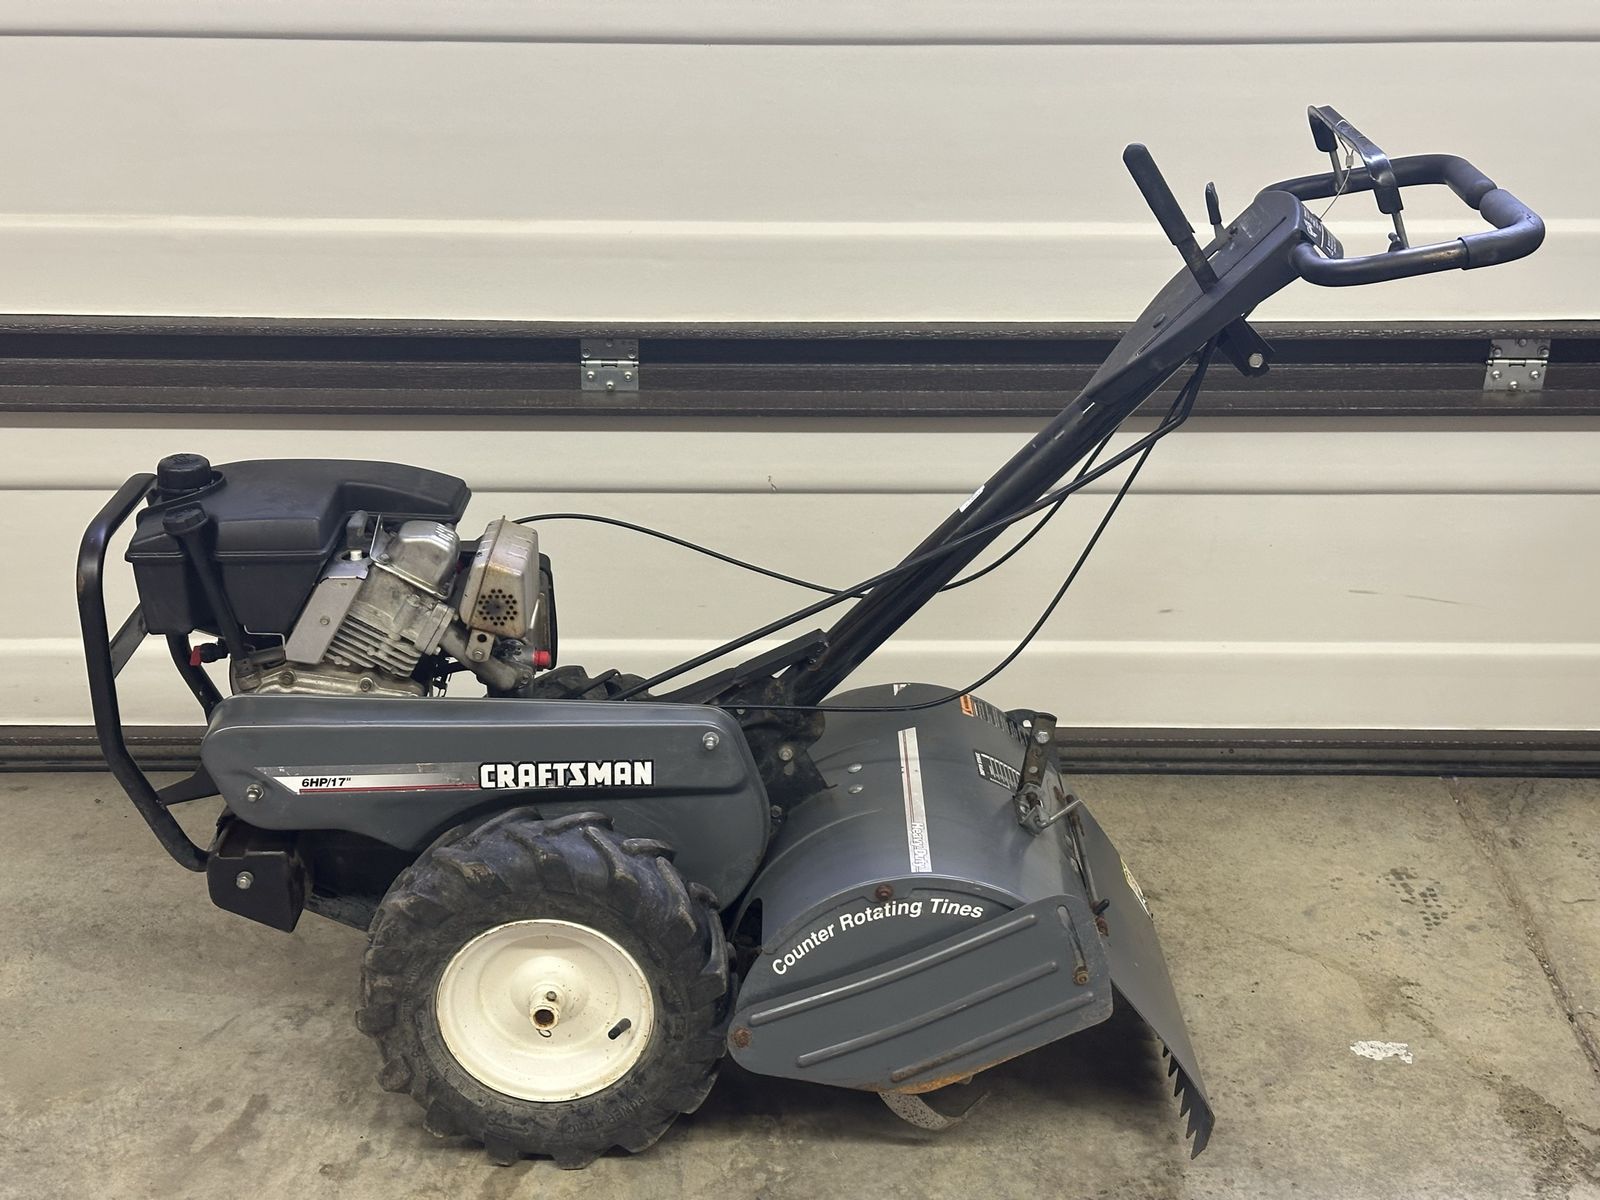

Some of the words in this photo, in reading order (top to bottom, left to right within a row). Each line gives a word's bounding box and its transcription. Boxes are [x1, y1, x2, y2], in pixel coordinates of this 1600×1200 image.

[301, 777, 352, 788] 6HP/17"
[479, 760, 654, 789] CRAFTSMAN
[772, 922, 835, 976] Counter
[839, 899, 924, 932] Rotating
[930, 898, 984, 919] Tines
